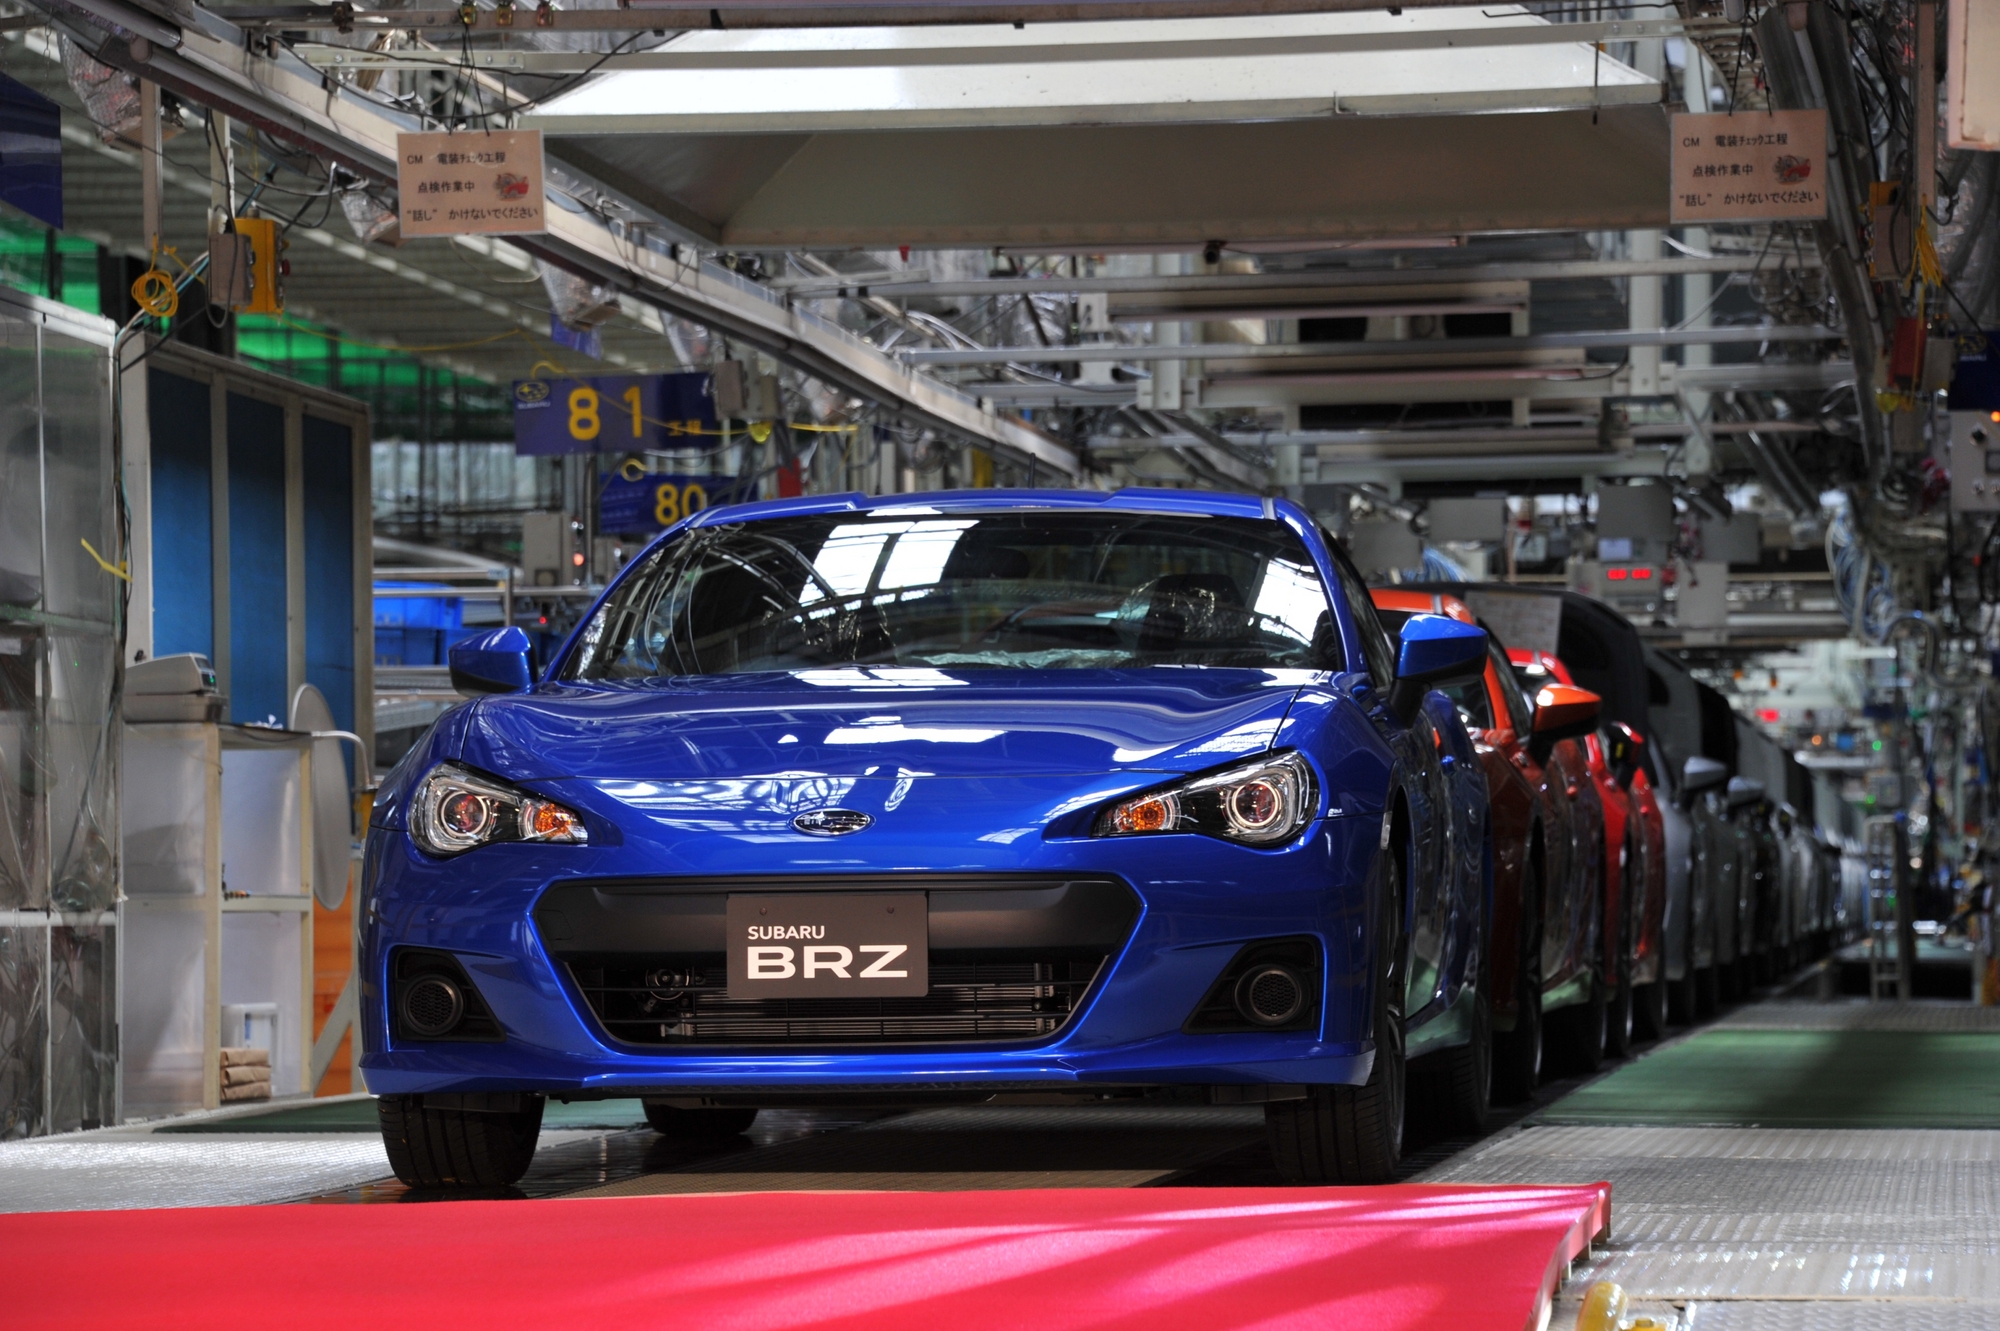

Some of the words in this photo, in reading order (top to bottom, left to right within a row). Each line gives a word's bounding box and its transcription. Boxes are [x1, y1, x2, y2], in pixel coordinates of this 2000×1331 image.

[1683, 137, 1700, 147] CM
[407, 155, 423, 165] CM
[1692, 164, 1753, 177] 点検作業中
[418, 181, 475, 193] 点検作業中
[1724, 191, 1819, 205] かけないでください
[448, 207, 539, 221] かけないでください
[655, 483, 707, 525] 80
[748, 925, 825, 940] SUBARU
[747, 944, 908, 979] BRZ
